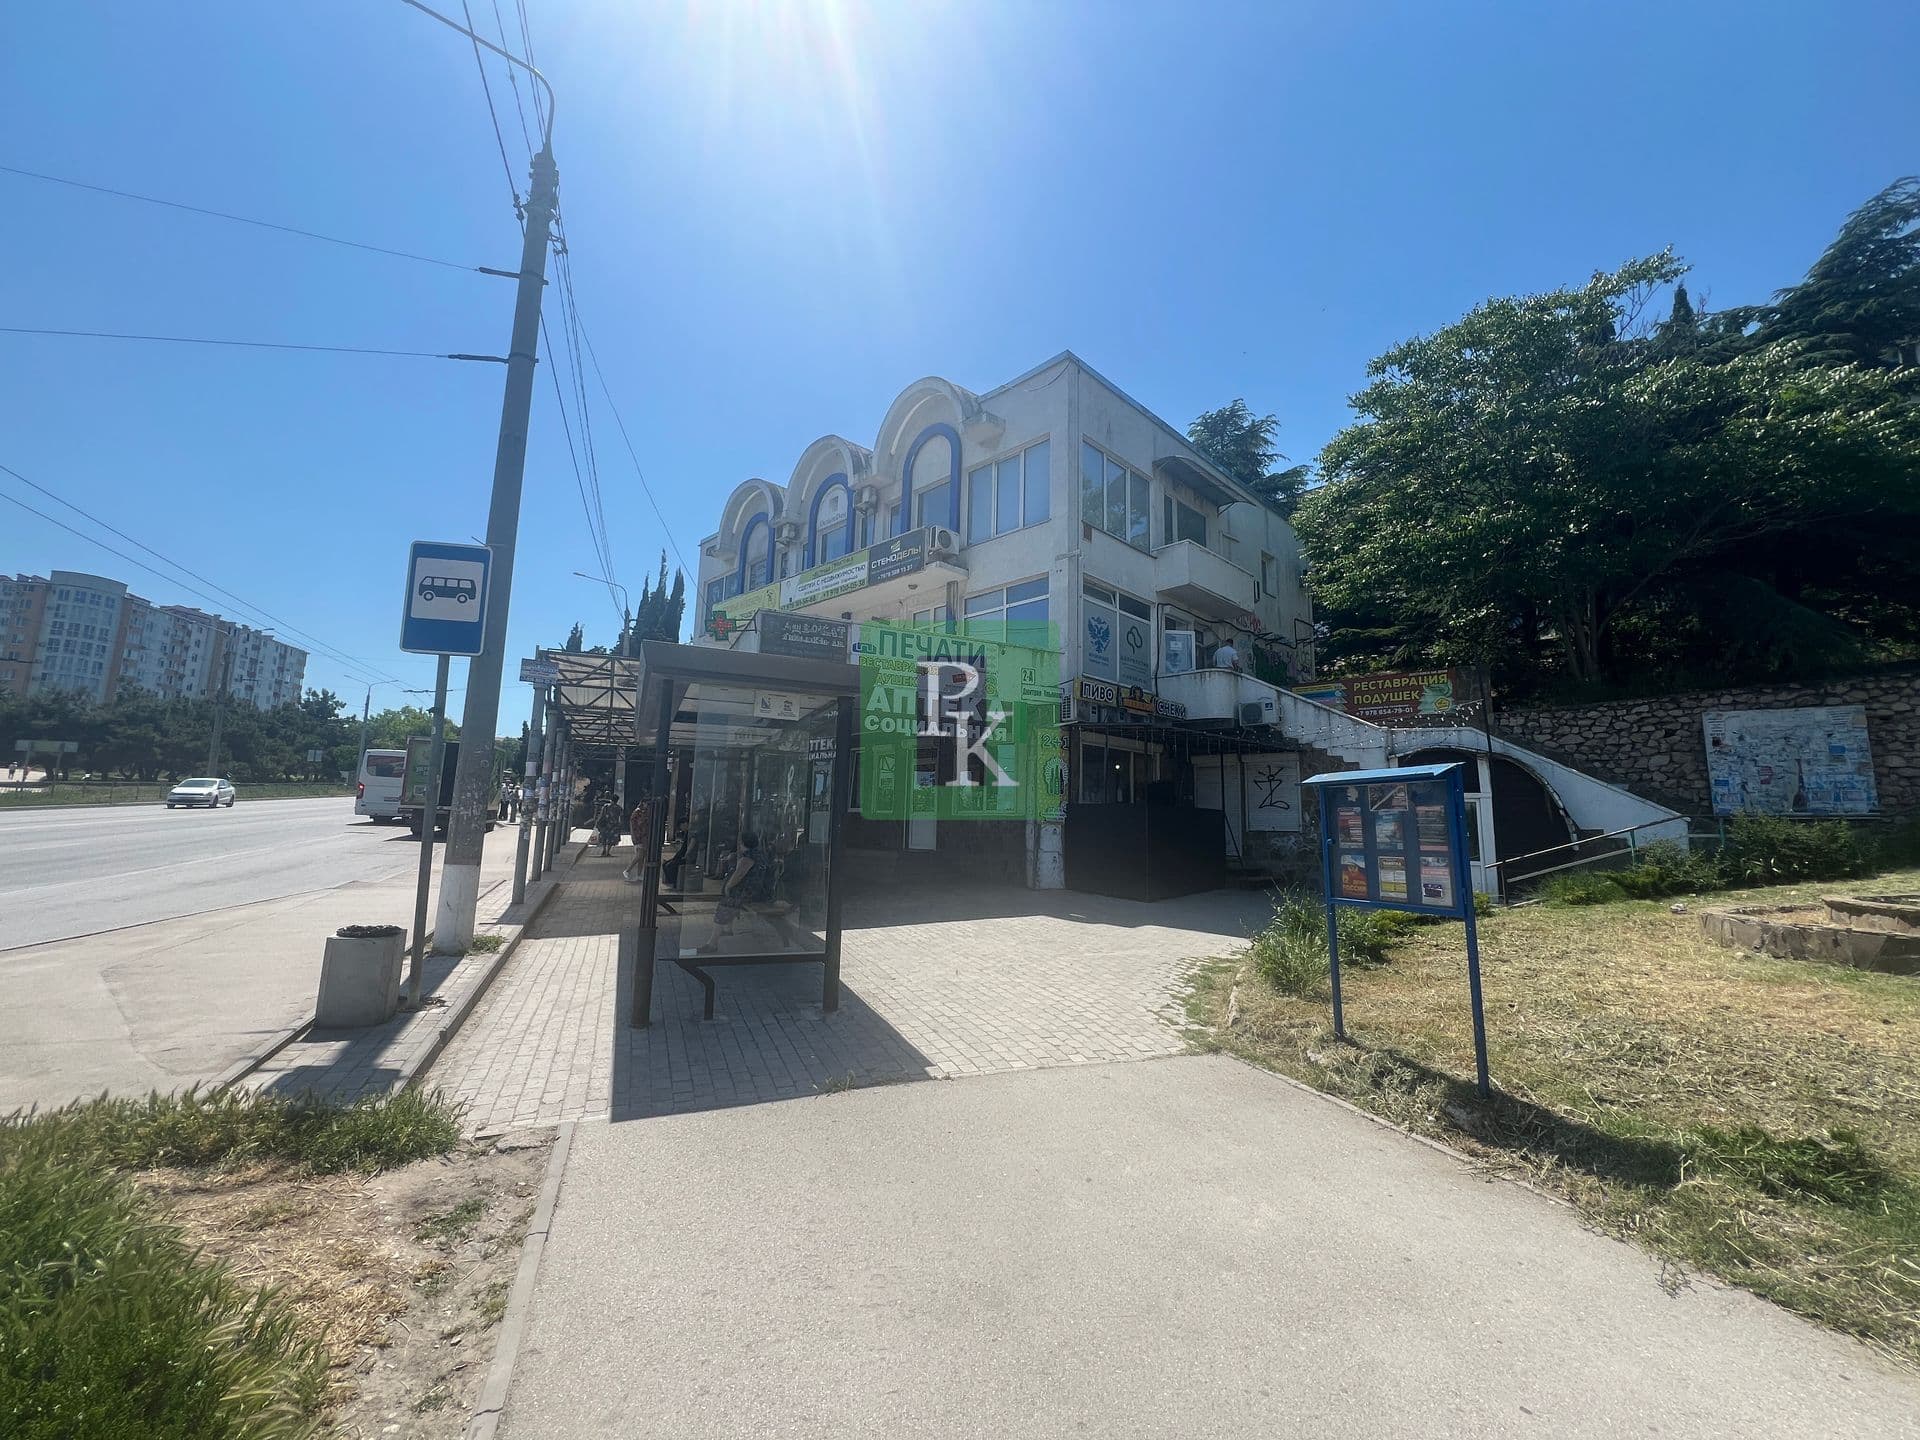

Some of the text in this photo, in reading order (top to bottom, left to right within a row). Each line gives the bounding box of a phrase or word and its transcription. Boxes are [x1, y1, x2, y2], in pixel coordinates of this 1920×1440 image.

[879, 630, 986, 669] ПЕЧАТИ
[1353, 673, 1448, 691] РЕСТАВРАЦИЯ
[1082, 682, 1114, 702] ПИВО
[1353, 690, 1421, 705] ПОДУШЕК
[866, 687, 1007, 722] АПТЕКА
[1041, 734, 1070, 750] 2+1
